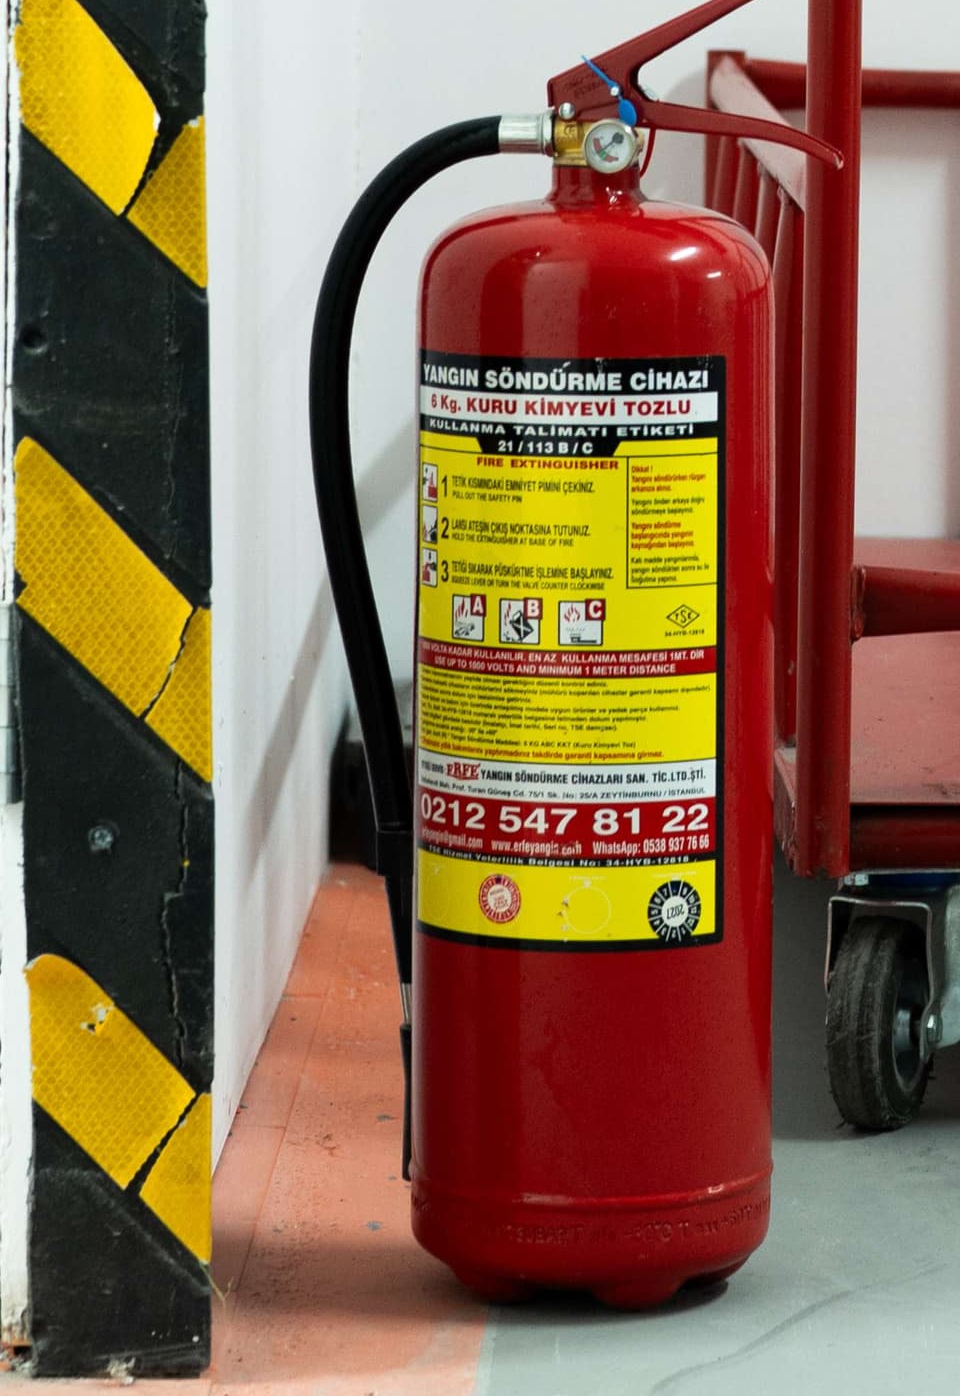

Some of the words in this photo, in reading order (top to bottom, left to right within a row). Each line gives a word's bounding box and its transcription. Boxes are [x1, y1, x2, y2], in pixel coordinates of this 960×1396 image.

[424, 364, 478, 386] YANGIN
[485, 367, 622, 390] SÖNDÜRME
[630, 368, 708, 390] CİHAZI
[431, 394, 437, 408] 6
[441, 395, 461, 413] Kg.
[467, 397, 517, 414] KURU
[525, 398, 615, 416] KİMYEVİ
[624, 400, 690, 416] TOZLU
[430, 418, 506, 434] KULLANMA
[514, 425, 607, 436] TALİMATI
[617, 423, 694, 436] ETİKETİ
[498, 440, 512, 452] 21
[528, 442, 553, 453] 113
[558, 442, 568, 454] B
[582, 442, 593, 454] C
[477, 457, 503, 466] FIRE
[510, 459, 618, 469] EXTINGUISHER
[442, 476, 447, 497] 1
[442, 517, 448, 538] 2
[441, 560, 448, 582] 3
[473, 597, 484, 613] A
[526, 600, 539, 616] B
[589, 601, 602, 618] C
[448, 646, 472, 657] KADAR
[473, 649, 526, 661] KULLANILIR.
[529, 653, 541, 662] EN
[544, 653, 556, 662] AZ
[562, 654, 617, 663] KULLANMA
[620, 652, 667, 663] MESAFESİ
[457, 659, 467, 668] TO
[487, 662, 514, 673] VOLTS
[516, 664, 536, 674] AND
[538, 665, 582, 675] MINIMUM
[592, 666, 626, 675] METER
[630, 664, 676, 675] DISTANCE
[480, 769, 512, 781] YANGIN
[515, 770, 568, 784] SÖNDÜRME
[572, 772, 622, 784] CİHAZLARI
[626, 772, 648, 784] SAN.
[421, 793, 485, 830] 0212
[499, 806, 577, 835] 547
[592, 808, 640, 836] 81
[662, 804, 709, 833] 22
[592, 841, 641, 856] WhatsApp:
[643, 838, 666, 853] 0538
[668, 837, 685, 851] 937
